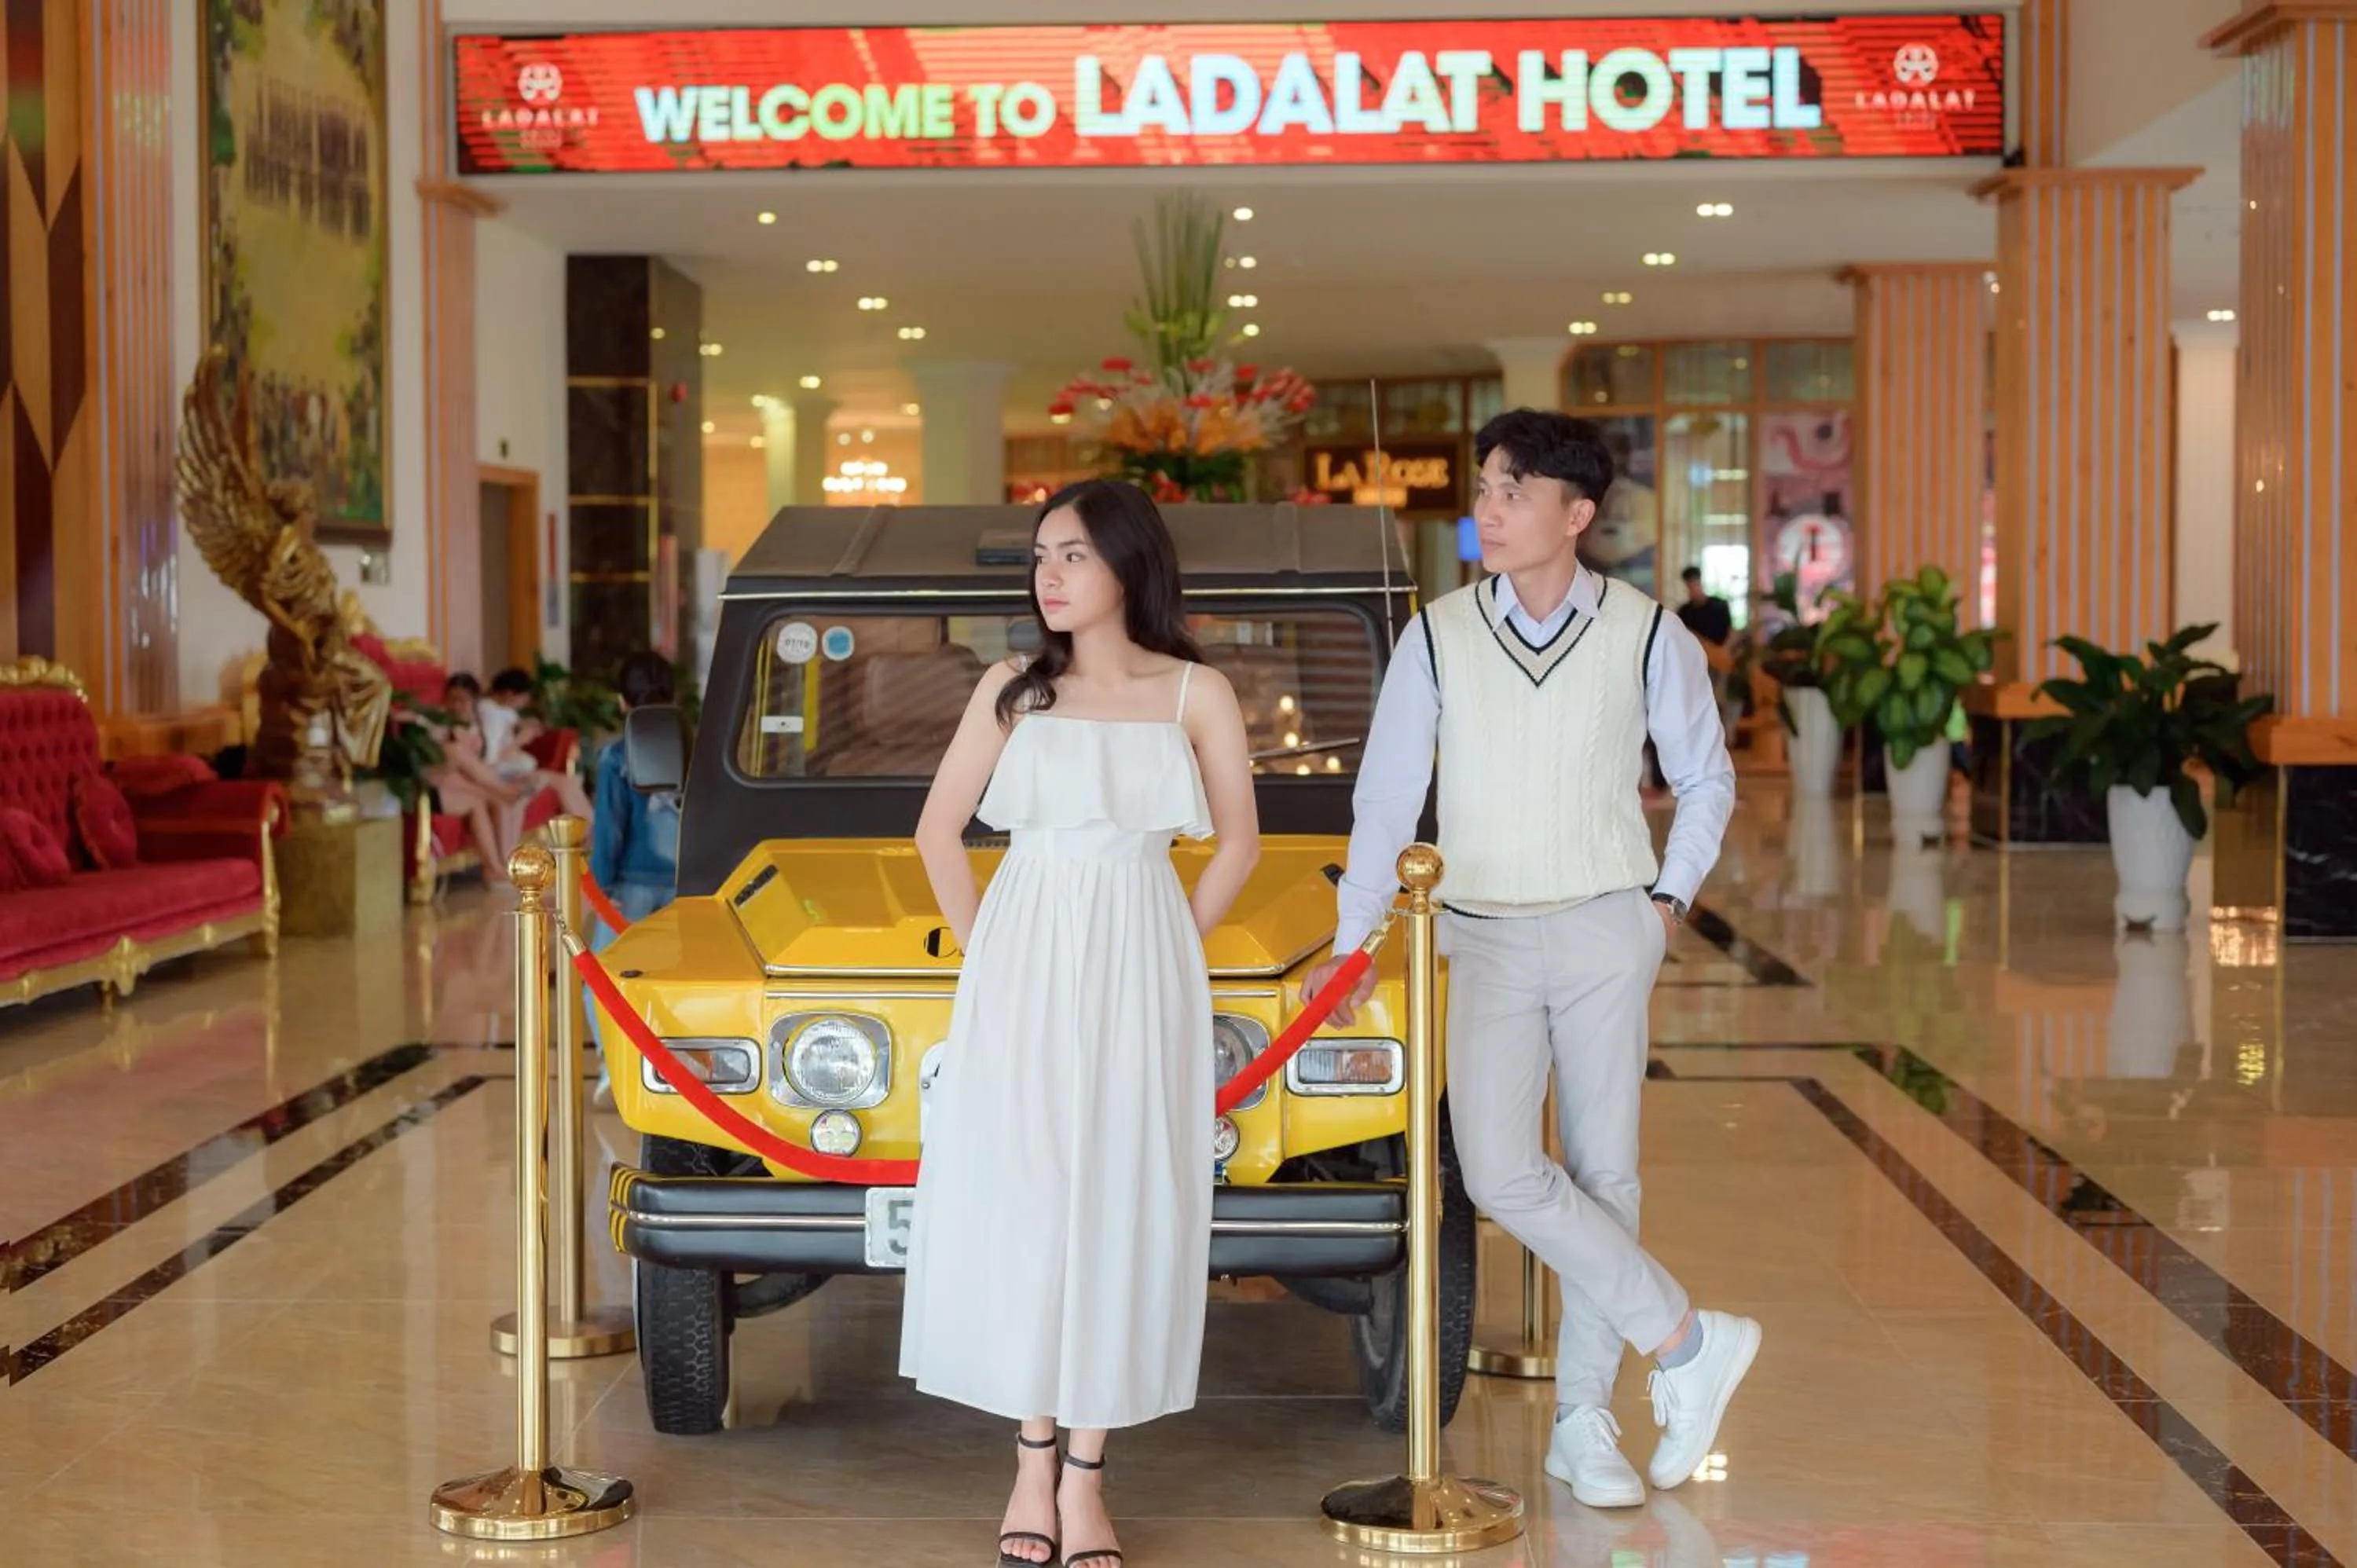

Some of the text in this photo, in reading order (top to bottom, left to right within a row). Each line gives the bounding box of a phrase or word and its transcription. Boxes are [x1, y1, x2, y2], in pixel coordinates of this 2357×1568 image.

[634, 46, 1822, 141] WELCOME TO LADALAT HOTEL
